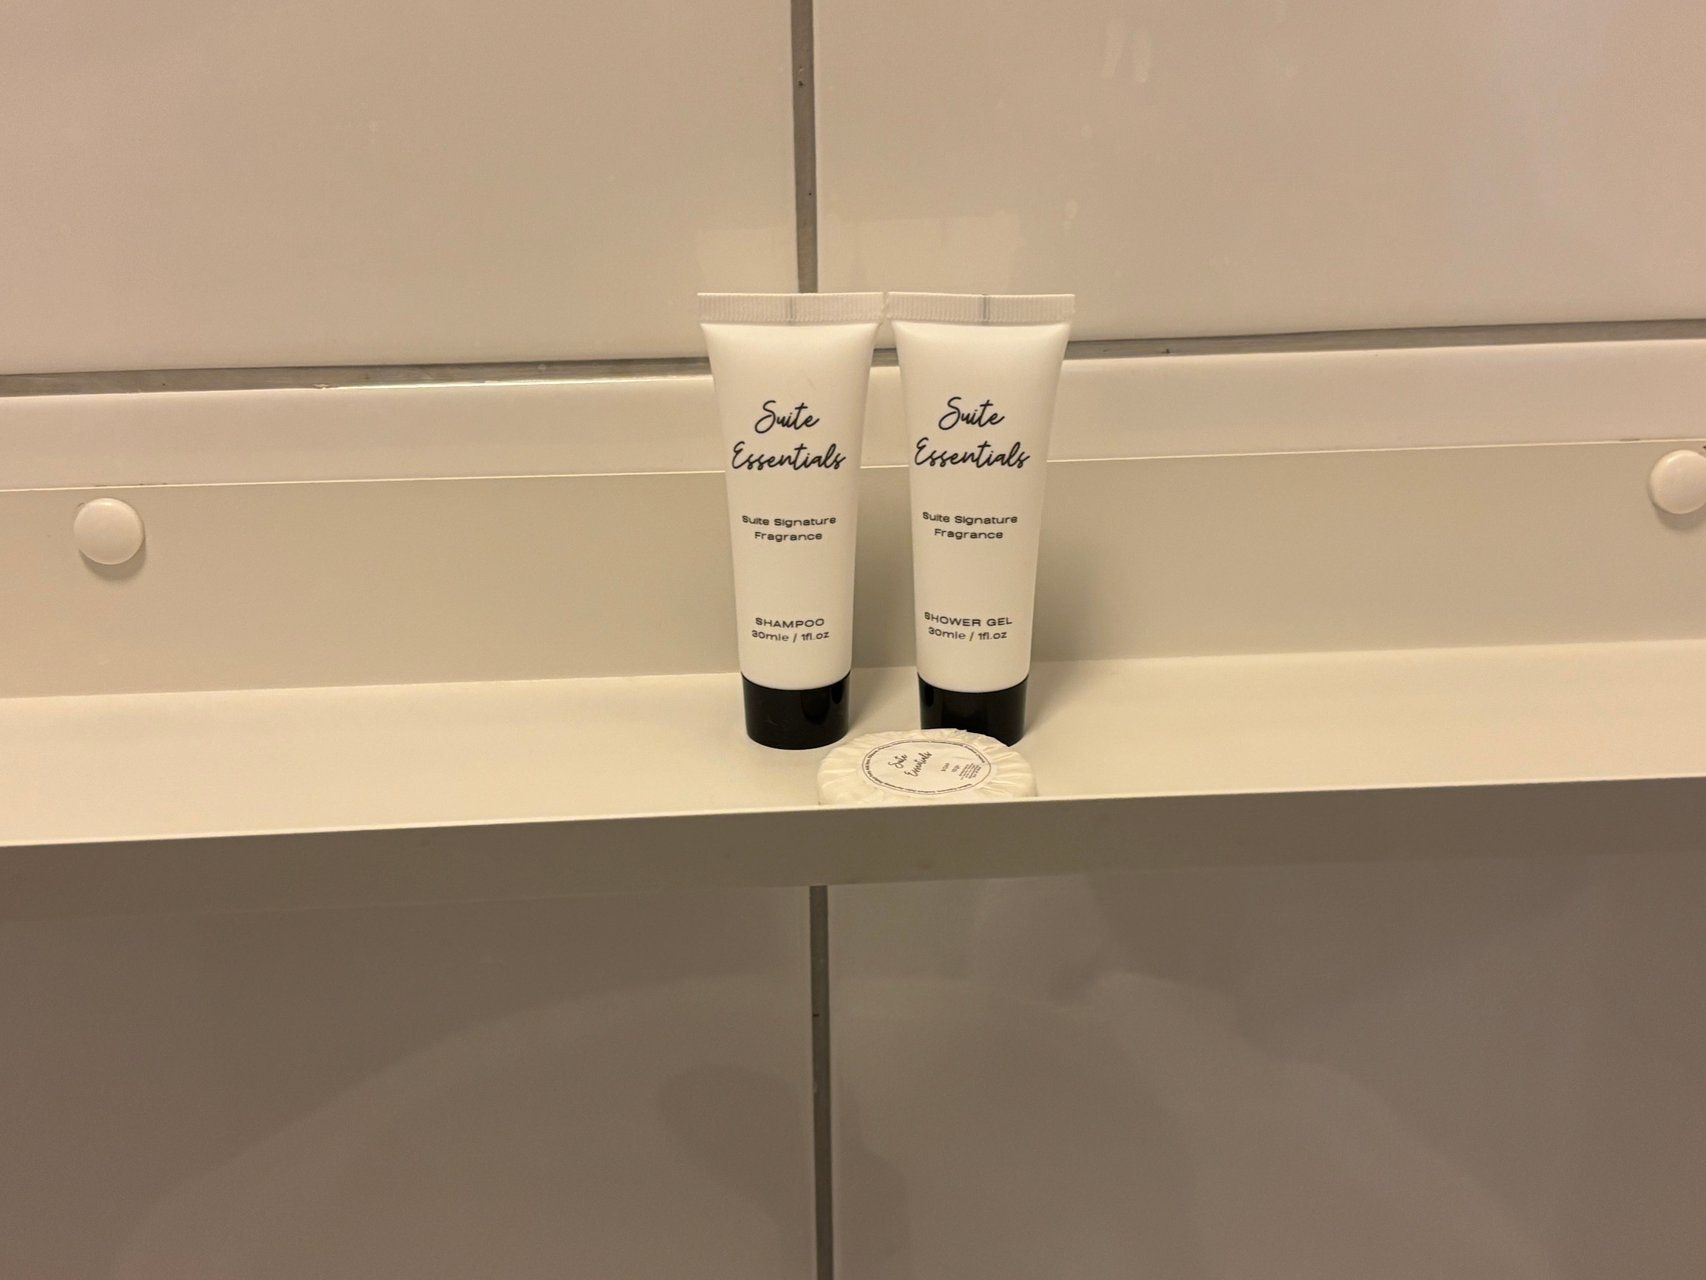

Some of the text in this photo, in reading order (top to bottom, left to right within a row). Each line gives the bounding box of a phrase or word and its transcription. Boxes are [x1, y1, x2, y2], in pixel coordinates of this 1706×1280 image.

[754, 400, 820, 434] Suite
[938, 396, 1005, 431] Suite
[732, 441, 846, 471] Essentials
[915, 437, 1030, 469] Essentials
[742, 515, 837, 528] Suite Signature
[922, 511, 1018, 527] Suite Signature
[754, 531, 823, 542] Fragrance
[934, 528, 1004, 540] Fragrance
[755, 617, 825, 628] SHAMPOO
[924, 611, 1013, 627] SHOWER GEL
[792, 633, 797, 643] /
[969, 631, 974, 642] /
